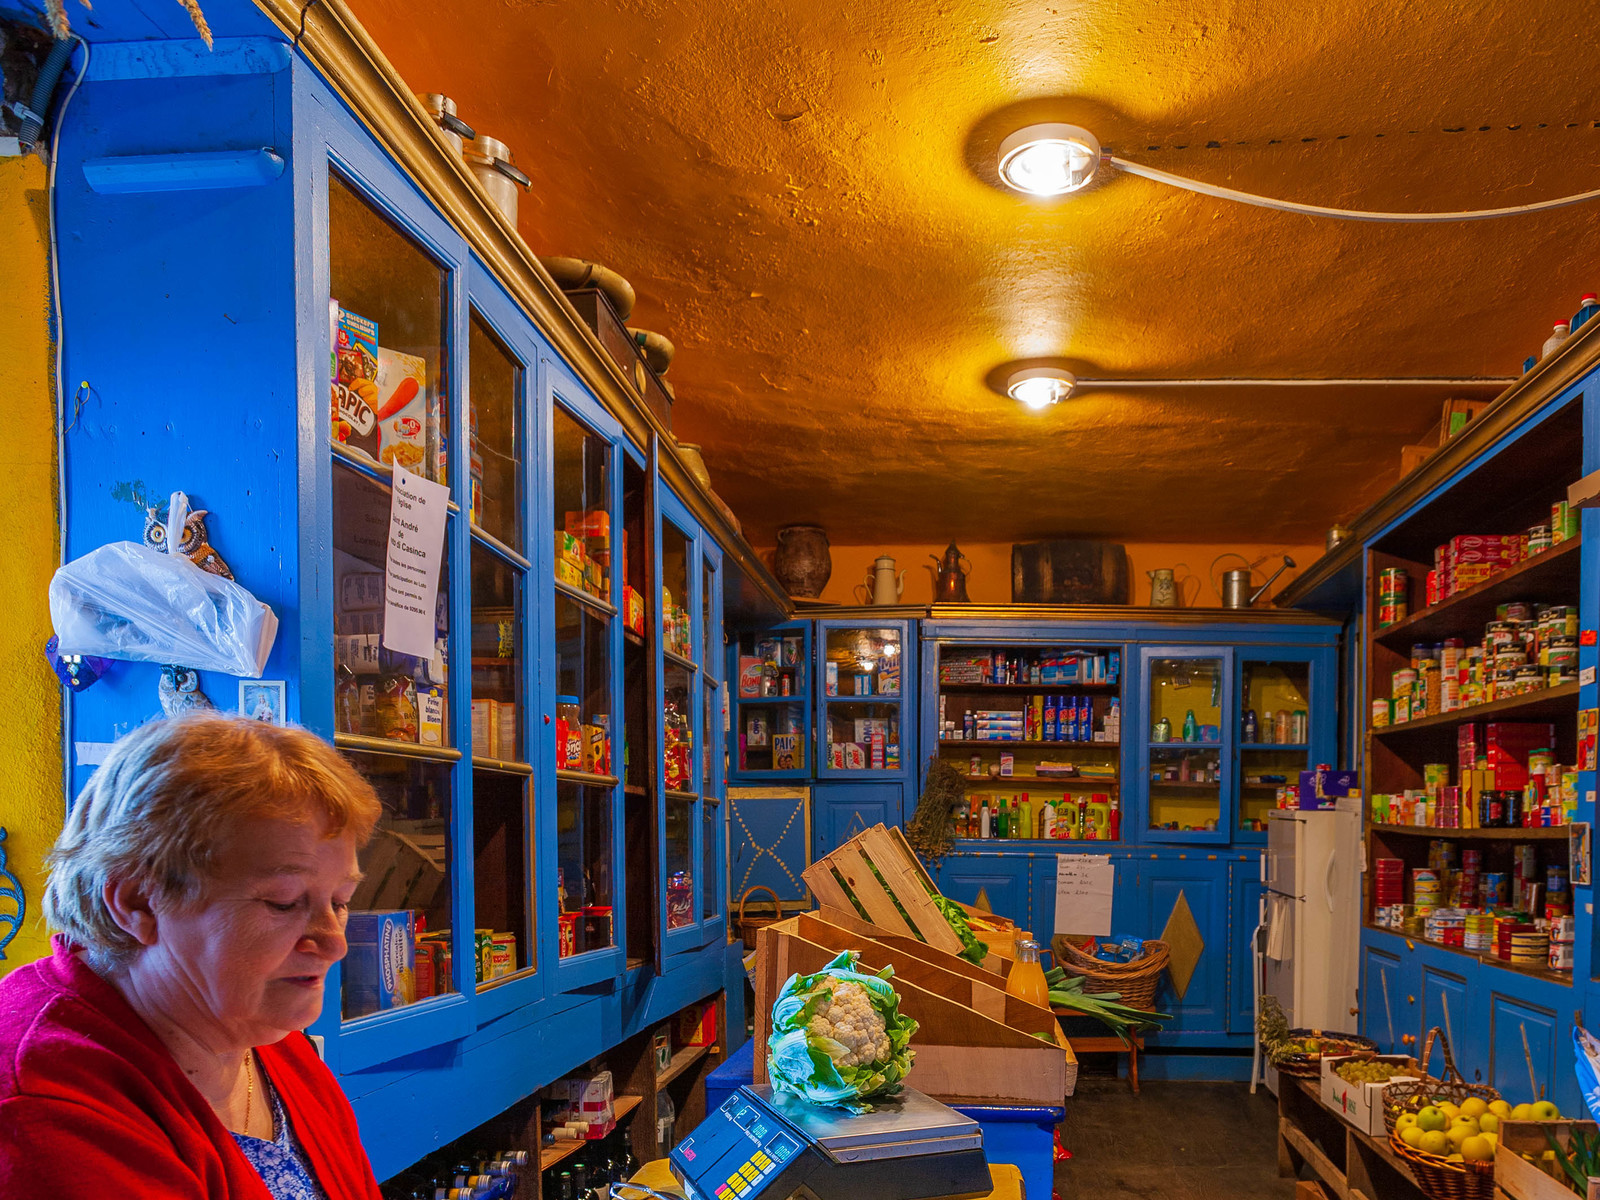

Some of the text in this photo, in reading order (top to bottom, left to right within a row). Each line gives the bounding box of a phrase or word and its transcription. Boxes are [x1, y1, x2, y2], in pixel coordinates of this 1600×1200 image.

[338, 387, 371, 425] APIC
[401, 520, 418, 532] André
[402, 542, 426, 558] Casinca
[864, 719, 872, 743] OMO
[775, 737, 796, 750] PAIC
[384, 922, 392, 990] PHOSPHATINE
